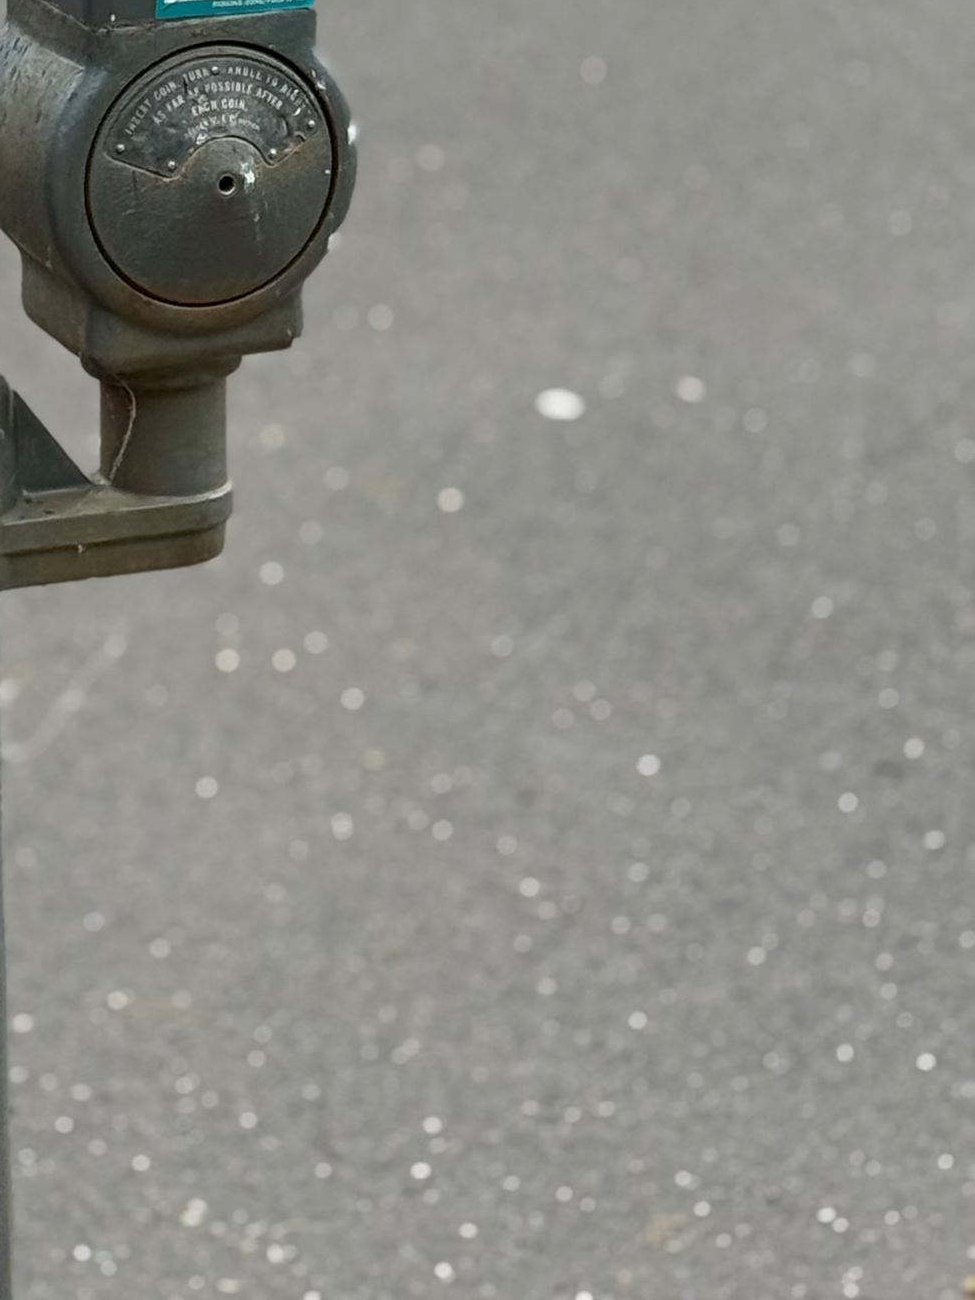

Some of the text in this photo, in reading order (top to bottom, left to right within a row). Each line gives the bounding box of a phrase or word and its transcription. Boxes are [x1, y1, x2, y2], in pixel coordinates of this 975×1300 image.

[204, 79, 254, 96] POSSIBLE
[255, 87, 284, 111] AFTER
[191, 100, 220, 117] EACH
